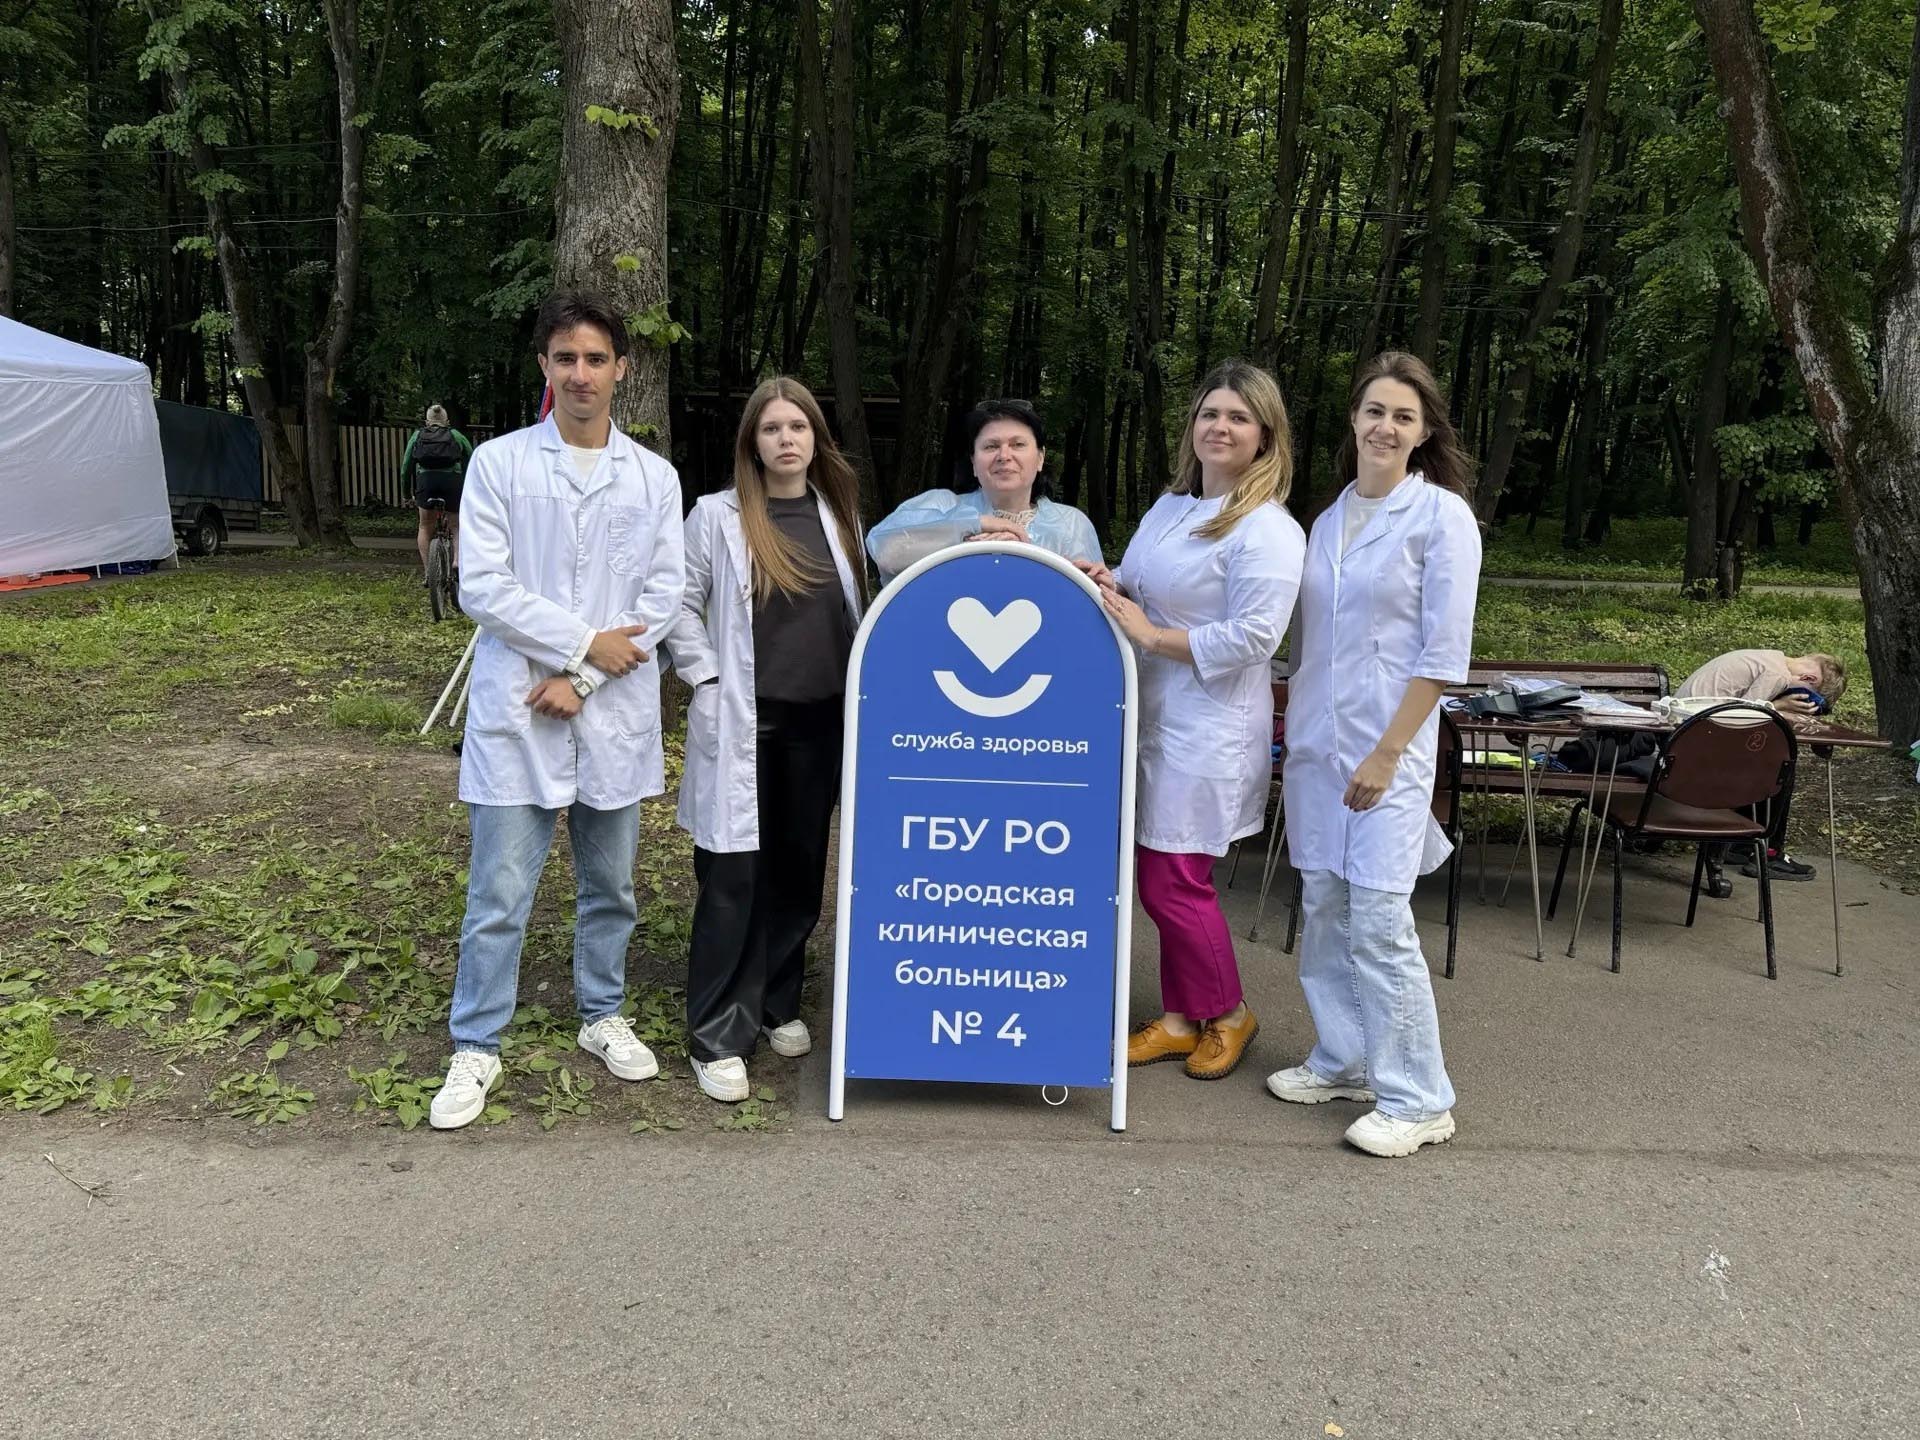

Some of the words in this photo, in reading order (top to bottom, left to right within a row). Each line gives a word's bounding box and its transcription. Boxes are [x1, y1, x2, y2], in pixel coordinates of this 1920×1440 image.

[891, 731, 975, 752] служба
[981, 737, 1089, 756] здоровья
[902, 815, 990, 852] ГБУ
[1004, 819, 1071, 855] РО
[895, 876, 1075, 908] «Городская
[878, 922, 1088, 950] клиническая
[895, 959, 1068, 992] больница»
[931, 1010, 983, 1046] №
[996, 1013, 1027, 1048] 4
